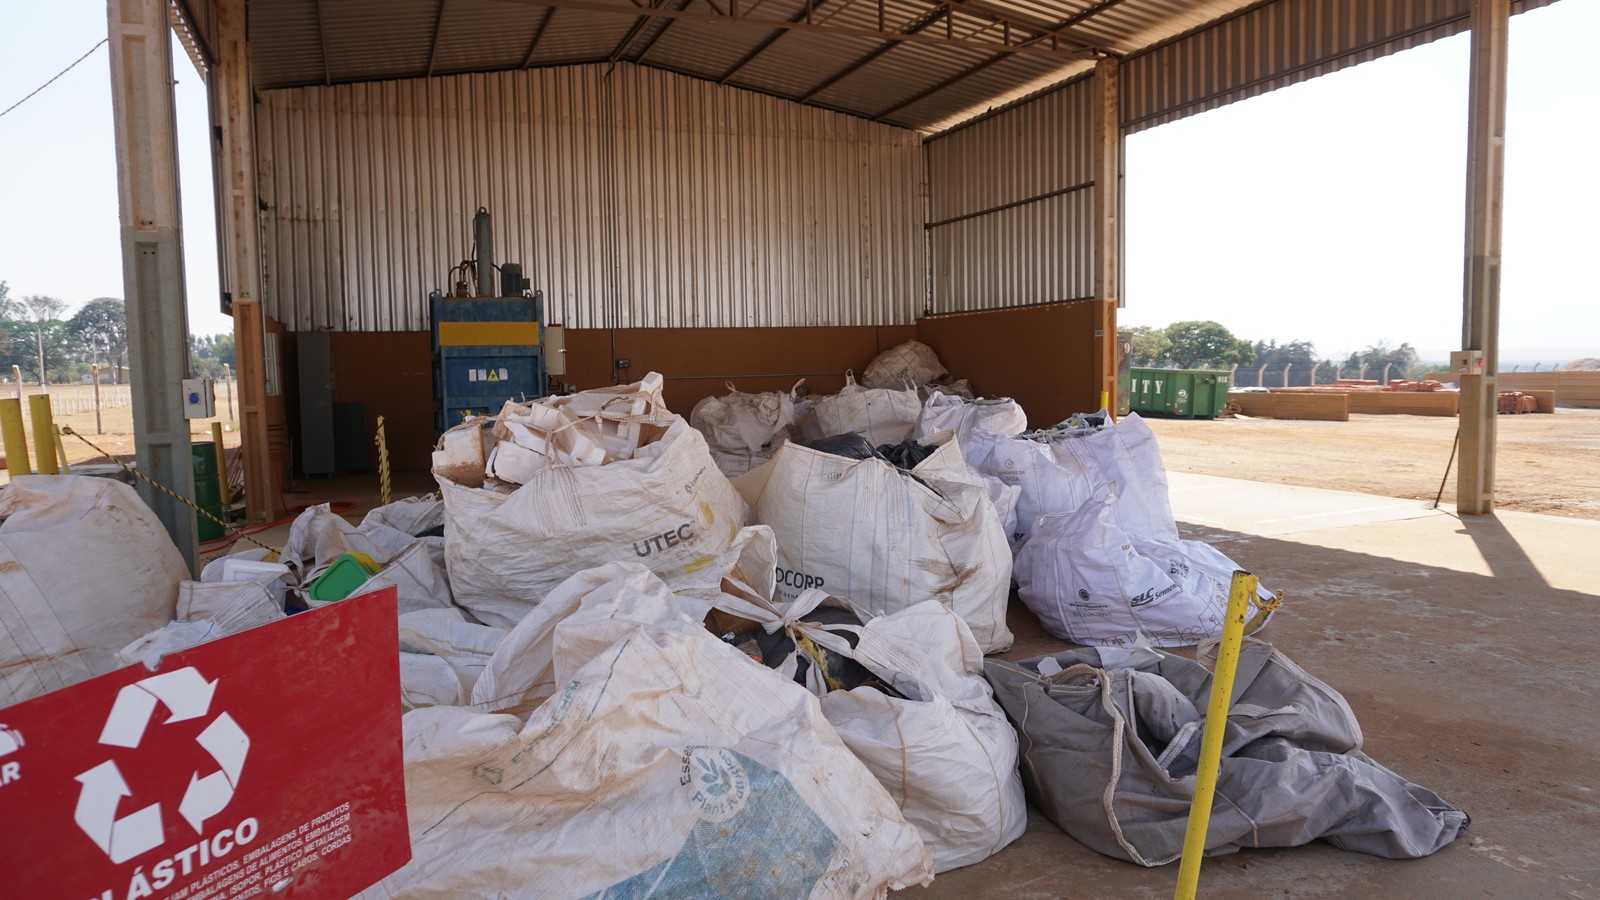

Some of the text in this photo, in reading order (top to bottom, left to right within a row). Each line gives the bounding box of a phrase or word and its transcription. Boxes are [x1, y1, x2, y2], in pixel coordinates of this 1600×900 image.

[1130, 587, 1154, 605] SLC
[89, 817, 258, 900] ÁSTICO
[243, 829, 297, 864] EMBALAGENS
[298, 822, 310, 835] DE
[311, 802, 350, 828] PRODUTOS
[246, 861, 258, 875] DE
[305, 812, 351, 842] EMBALAGEM
[263, 871, 282, 888] FIOS
[283, 867, 290, 877] E
[321, 834, 352, 856] CORDAS
